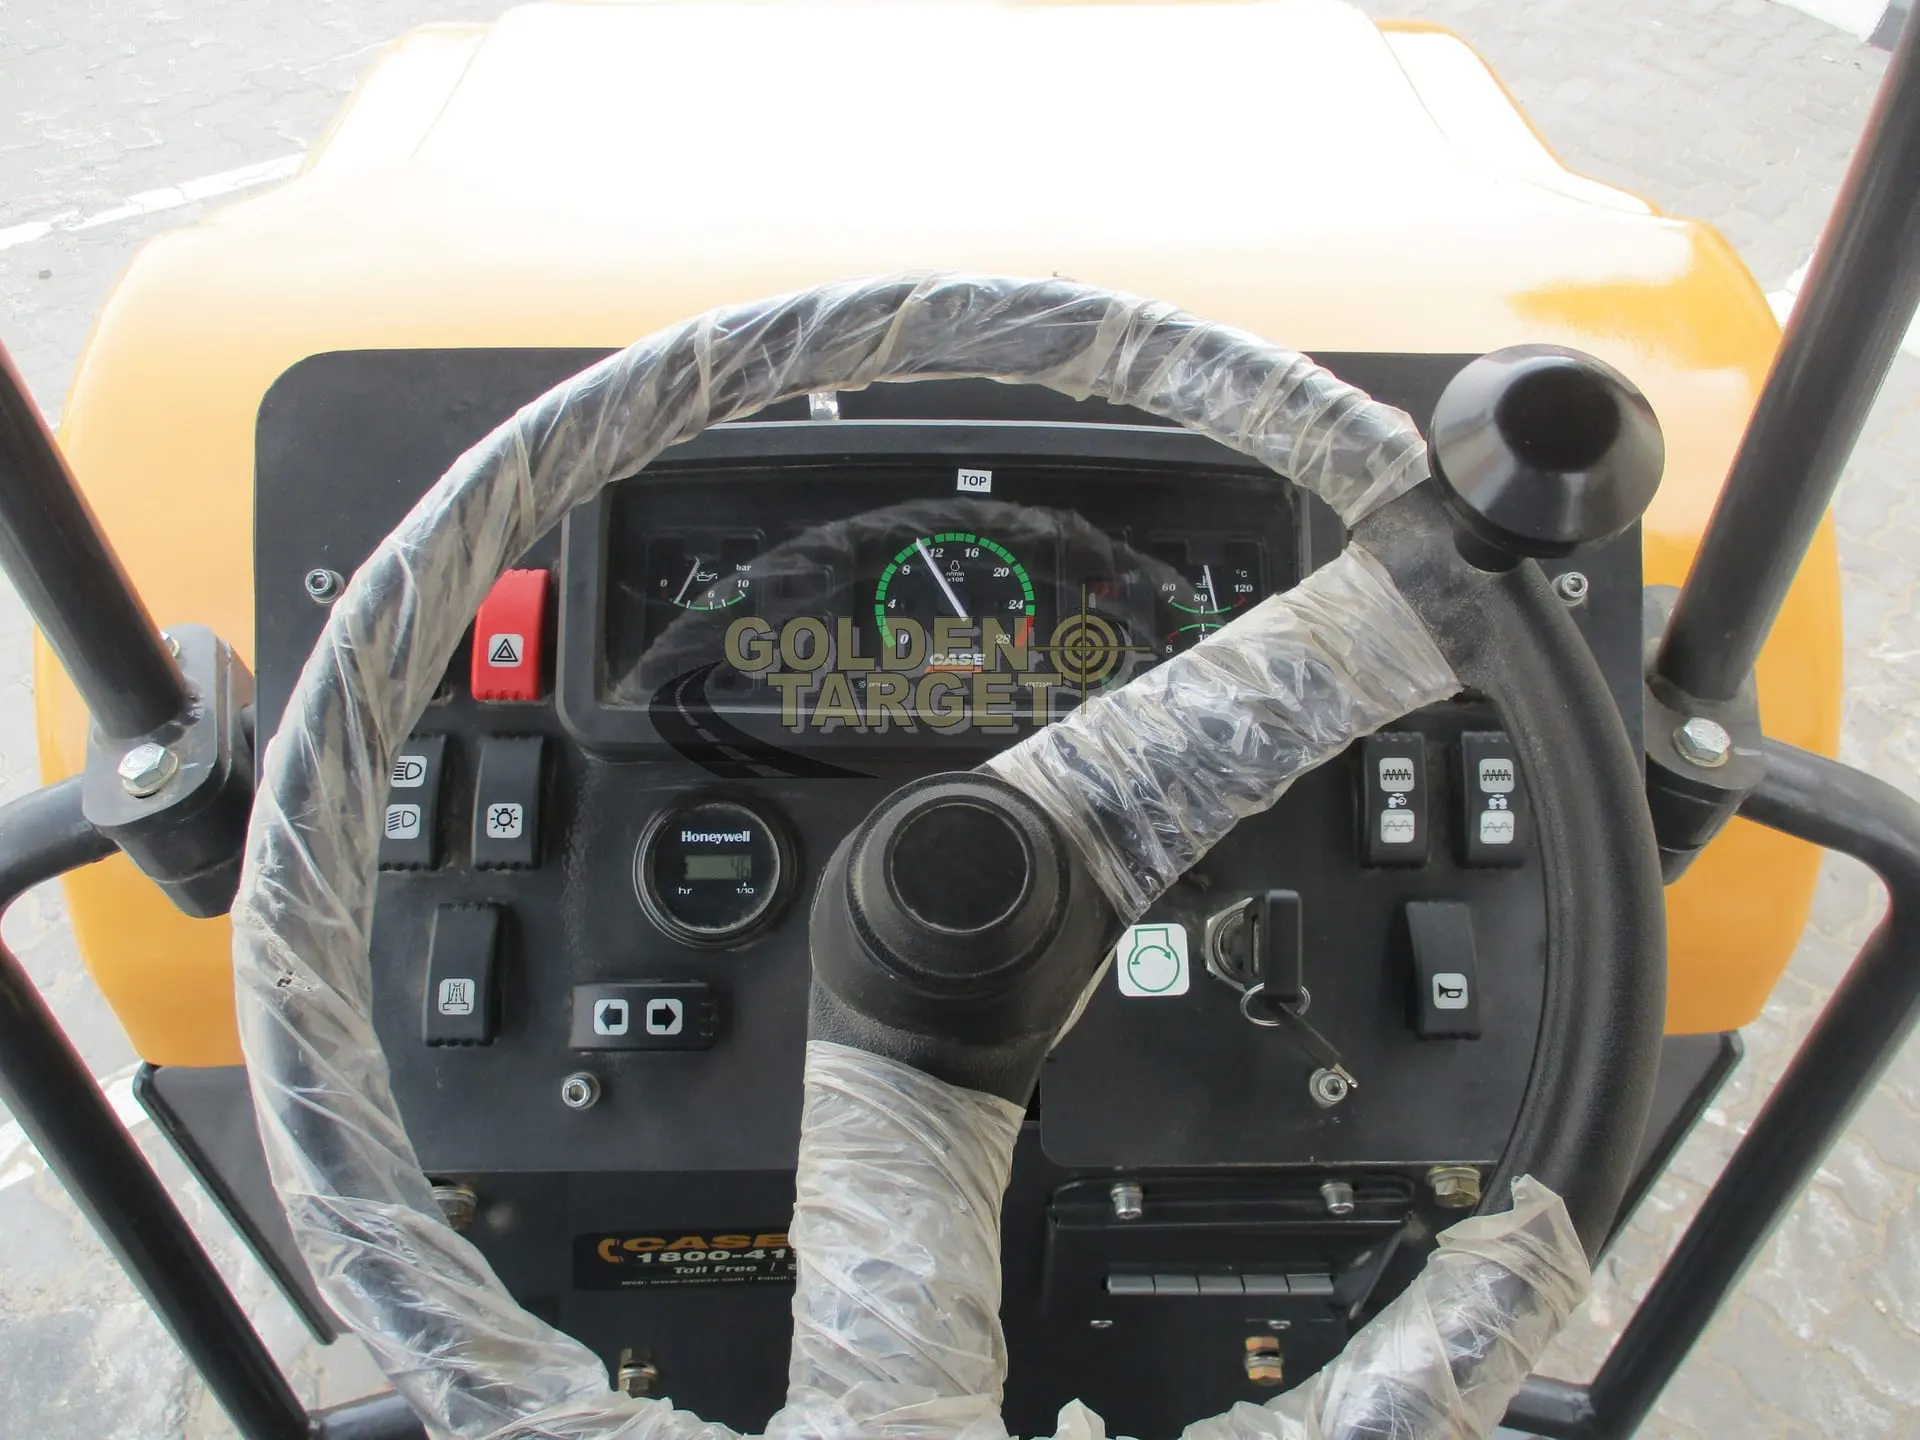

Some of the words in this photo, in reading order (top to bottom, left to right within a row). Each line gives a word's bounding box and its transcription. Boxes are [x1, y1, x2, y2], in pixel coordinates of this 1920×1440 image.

[962, 475, 987, 486] TOP
[929, 548, 944, 558] 12
[965, 548, 980, 558] 16
[902, 565, 911, 575] 8
[993, 567, 1010, 577] 20
[660, 579, 668, 587] 0
[737, 580, 750, 588] 10
[1234, 584, 1254, 592] 120
[1194, 594, 1208, 602] 80
[888, 599, 896, 609] 4
[1008, 600, 1024, 610] 24
[900, 633, 909, 644] 0
[1166, 645, 1173, 653] 8
[930, 653, 986, 666] CASE
[681, 831, 751, 844] Honeywell
[678, 887, 692, 895] hr
[623, 1233, 790, 1251] CASE
[637, 1248, 796, 1263] 1800-41
[674, 1265, 708, 1275] Toll
[714, 1264, 758, 1273] Free
